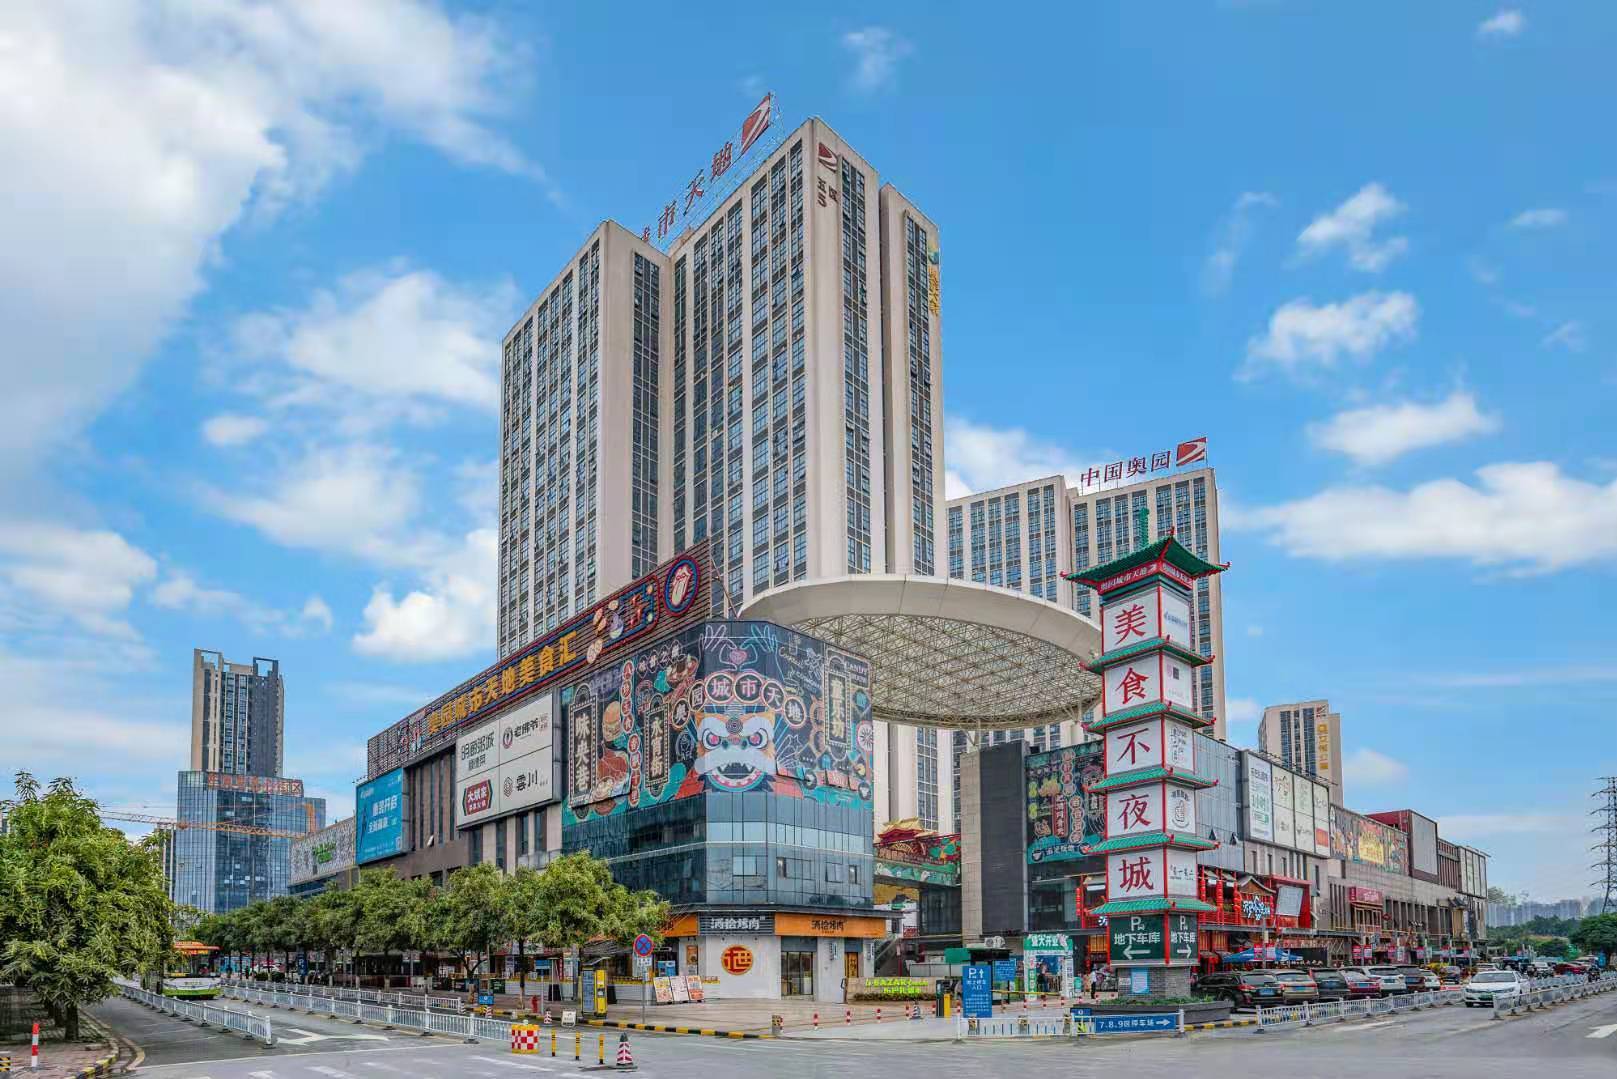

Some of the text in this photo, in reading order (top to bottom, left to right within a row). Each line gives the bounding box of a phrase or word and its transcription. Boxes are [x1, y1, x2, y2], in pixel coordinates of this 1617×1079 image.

[1080, 450, 1171, 487] 中国奥园
[428, 631, 577, 736] 奥园城市天地美食汇
[674, 679, 805, 726] 奥园城市天地
[1115, 604, 1154, 893] 美食不夜城
[1131, 916, 1141, 931] P
[1032, 934, 1059, 947] 盛大开业
[1114, 932, 1160, 945] 地下车库
[1170, 932, 1196, 943] 地下车库
[969, 968, 977, 978] P
